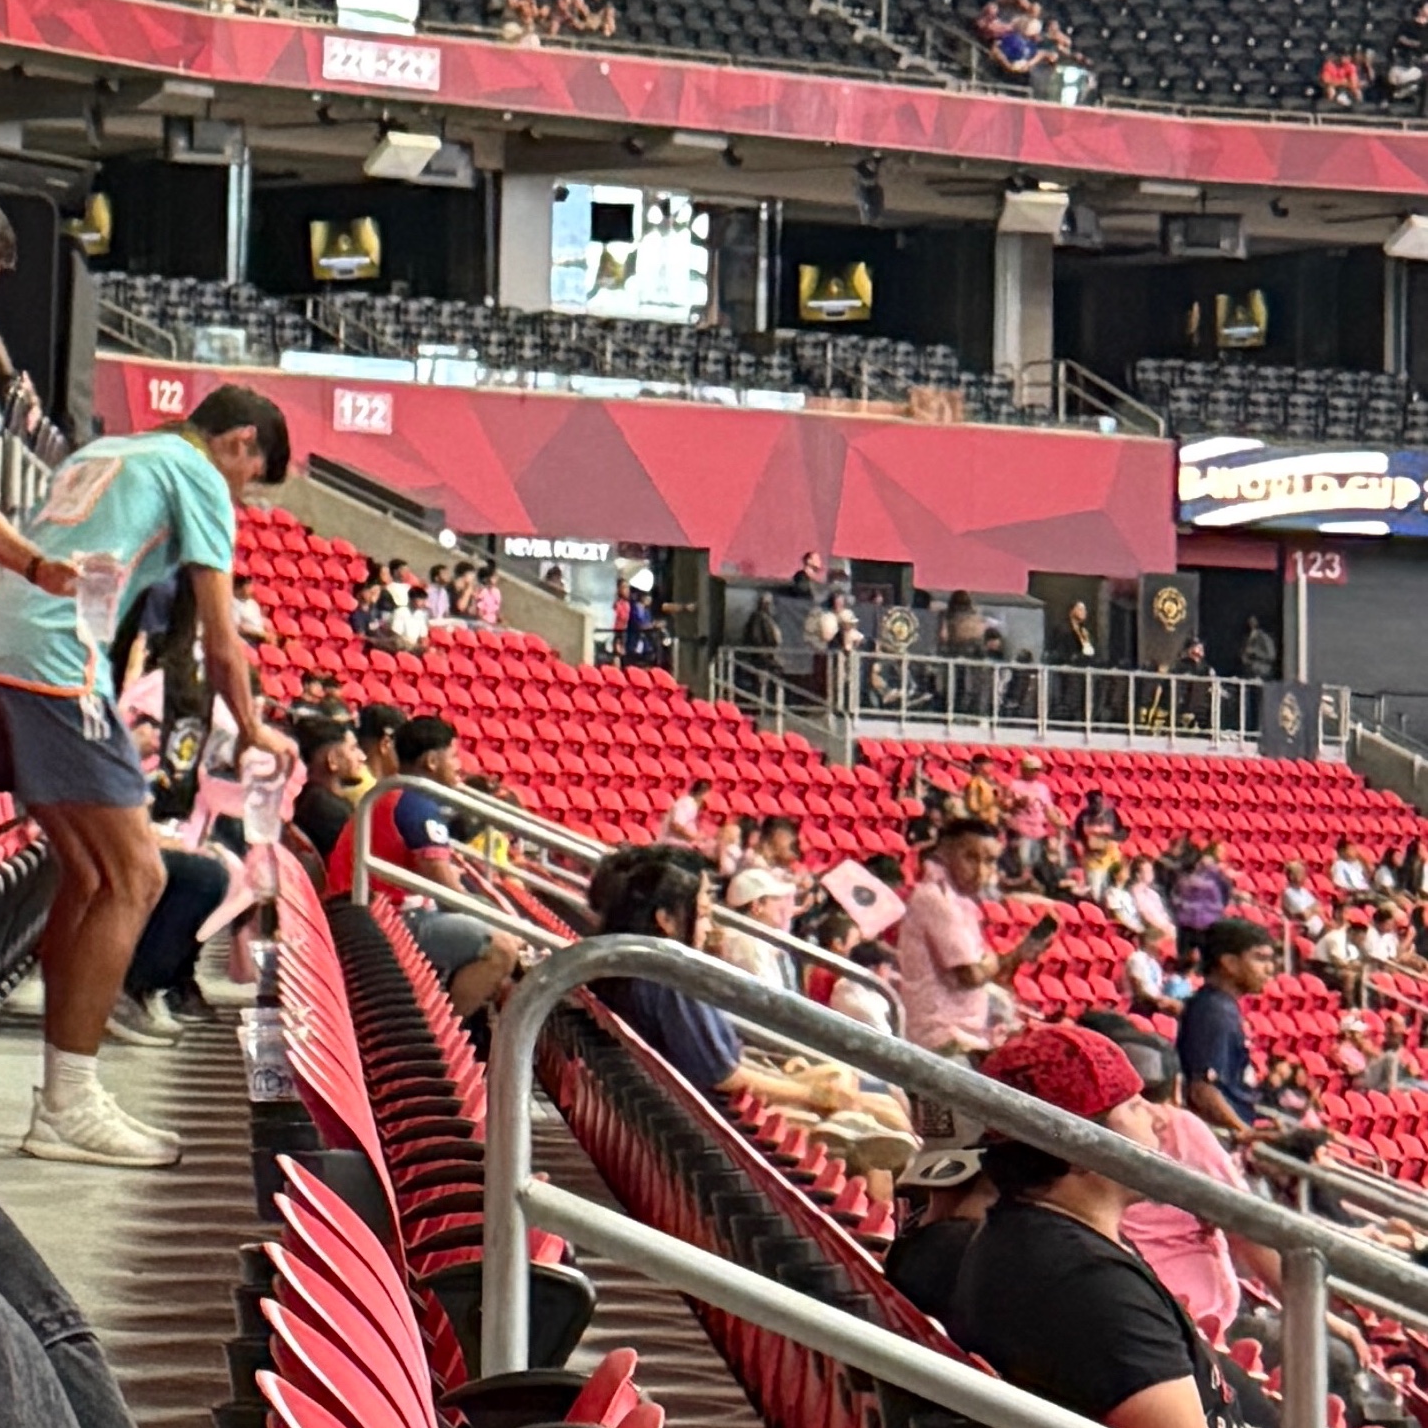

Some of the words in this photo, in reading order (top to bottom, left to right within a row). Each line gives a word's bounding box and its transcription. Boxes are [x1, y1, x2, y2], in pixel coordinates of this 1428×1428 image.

[149, 378, 185, 413] 122
[338, 393, 387, 429] 122
[1292, 550, 1342, 579] 123
